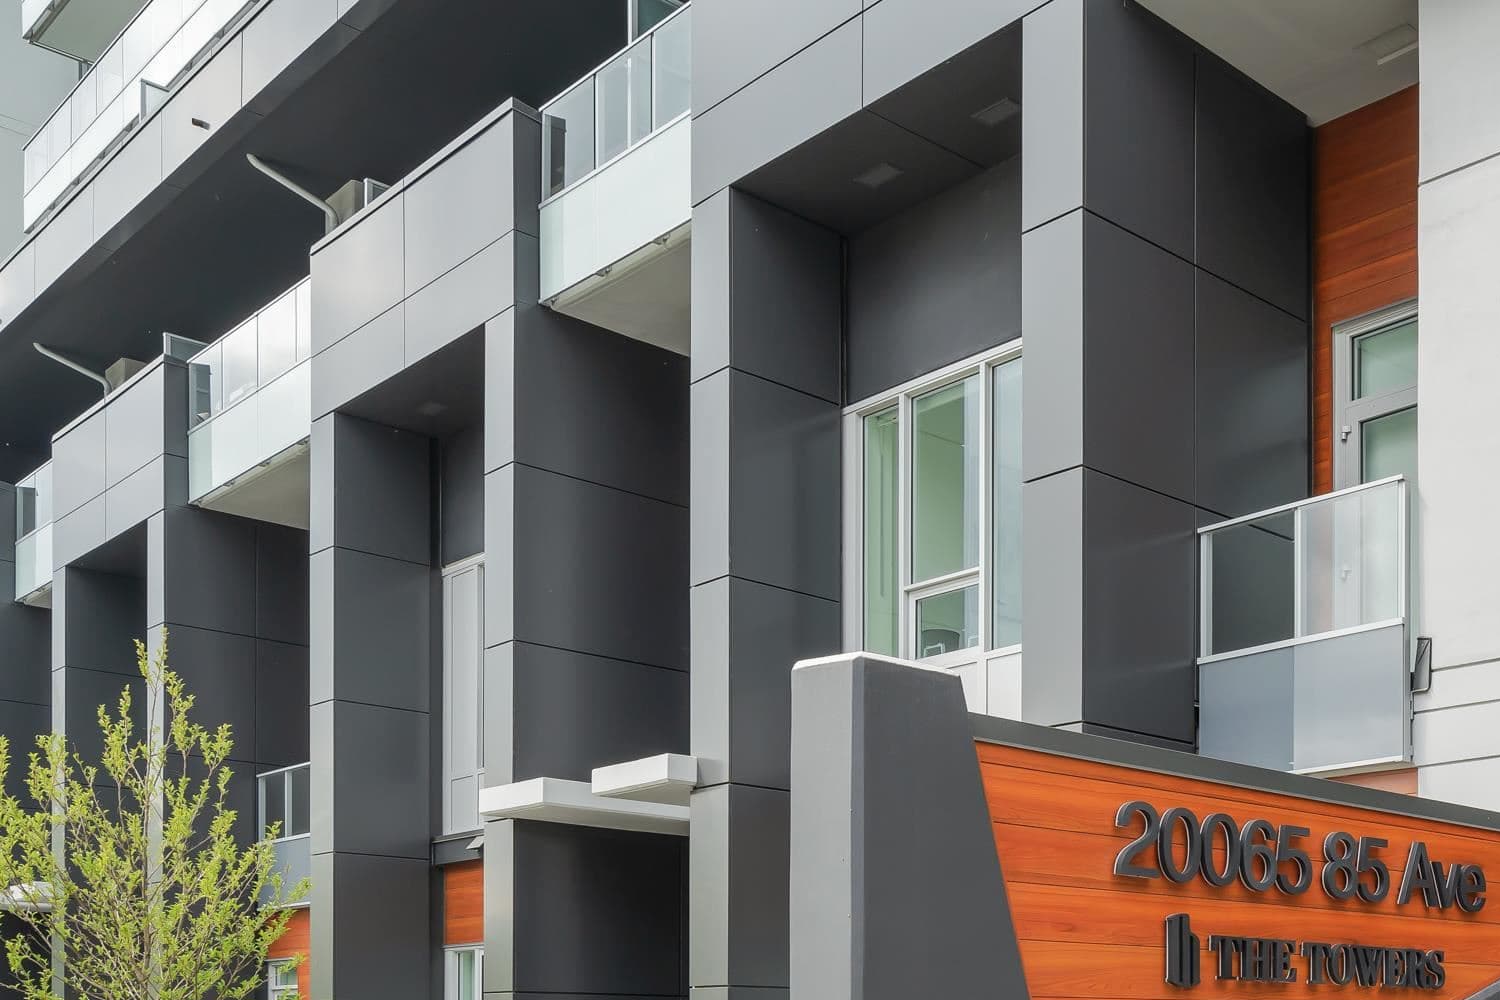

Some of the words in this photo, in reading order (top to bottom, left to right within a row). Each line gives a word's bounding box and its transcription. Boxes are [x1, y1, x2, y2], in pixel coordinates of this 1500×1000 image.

[1114, 801, 1312, 895] 20065
[1321, 831, 1390, 902] 85
[1397, 841, 1487, 912] Ave
[1208, 934, 1297, 983] THE
[1300, 940, 1445, 989] TOWERS
